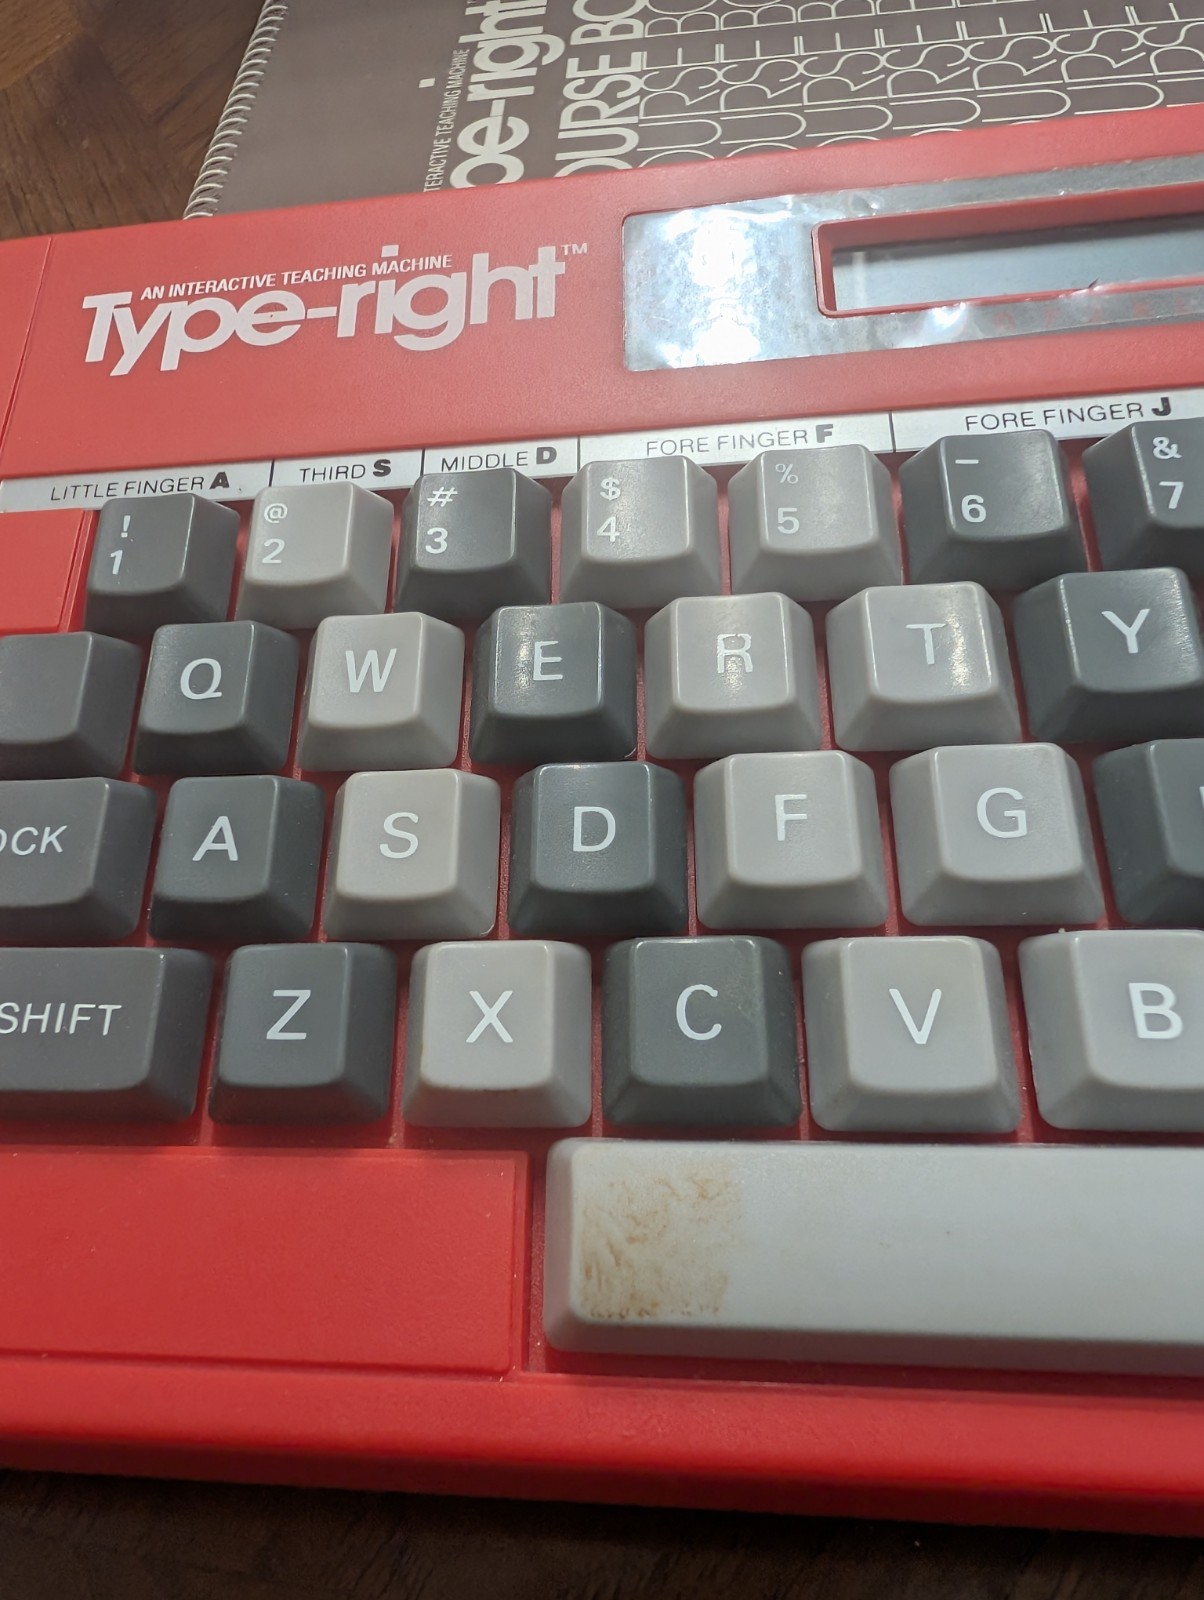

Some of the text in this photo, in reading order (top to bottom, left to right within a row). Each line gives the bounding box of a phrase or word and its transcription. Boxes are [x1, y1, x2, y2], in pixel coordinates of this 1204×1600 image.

[446, 48, 470, 89] MACHINE
[434, 89, 462, 136] TEACHING
[141, 254, 453, 300] AN INTERACTIVE TEACHING MACHINE
[82, 244, 566, 376] Type-right
[965, 397, 1171, 431] FORE FINGER J
[441, 447, 557, 472] MIDDLE D
[646, 424, 833, 456] FORE FINGER F
[50, 472, 229, 501] LITTLE FINGER A
[300, 459, 391, 482] THIRD S
[962, 495, 986, 522] 6
[1160, 482, 1183, 509] 7
[426, 527, 447, 553] 3
[596, 516, 620, 543] 4
[778, 508, 799, 534] 5
[111, 550, 122, 574] 1
[262, 539, 284, 563] 2
[905, 622, 947, 665] T
[1102, 609, 1150, 653] Y
[346, 648, 397, 692] W
[533, 641, 563, 680] E
[716, 633, 754, 674] R
[181, 658, 222, 699] Q
[573, 806, 615, 851] D
[775, 794, 807, 841] F
[977, 788, 1027, 838] G
[0, 826, 67, 855] CK
[193, 816, 238, 861] A
[380, 812, 418, 858] S
[0, 1003, 122, 1035] SHIFT
[267, 990, 311, 1039] Z
[466, 991, 513, 1042] X
[677, 984, 721, 1040] C
[889, 989, 941, 1044] V
[1129, 983, 1182, 1039] B
